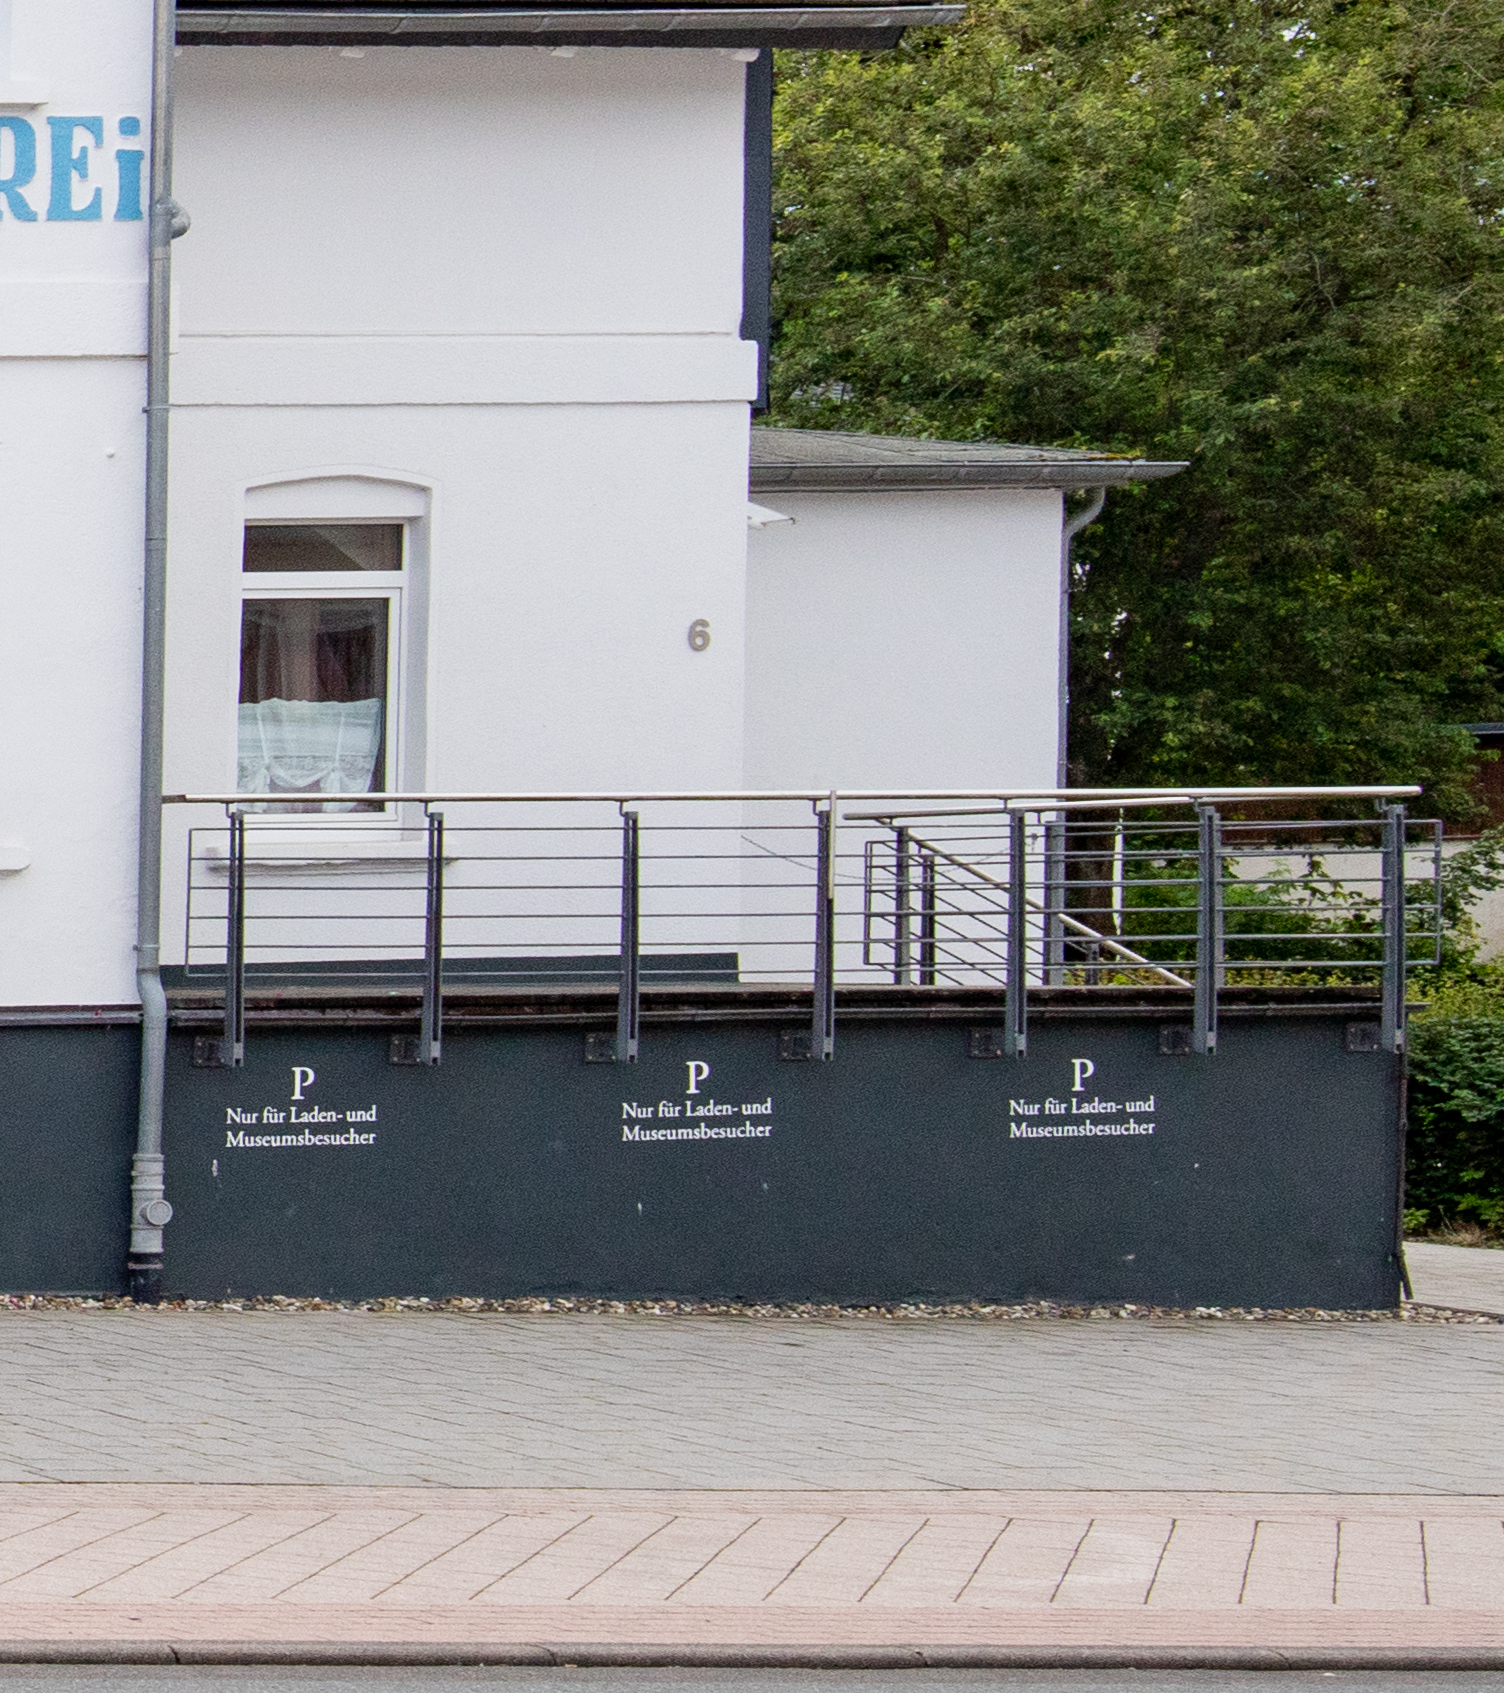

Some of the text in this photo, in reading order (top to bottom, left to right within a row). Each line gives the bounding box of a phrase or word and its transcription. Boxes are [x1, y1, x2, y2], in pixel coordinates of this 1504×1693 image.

[688, 618, 711, 652] 6
[291, 1067, 315, 1100] P
[686, 1061, 709, 1094] P
[1072, 1059, 1094, 1091] P
[226, 1105, 377, 1124] Nur für Laden- und
[622, 1098, 772, 1119] Nur für Laden- und
[1010, 1096, 1155, 1115] Nur für Laden- und
[226, 1128, 376, 1148] Museumsbesucher
[622, 1121, 772, 1141] Museumsbesucher
[1010, 1119, 1155, 1138] Museumsbesucher
